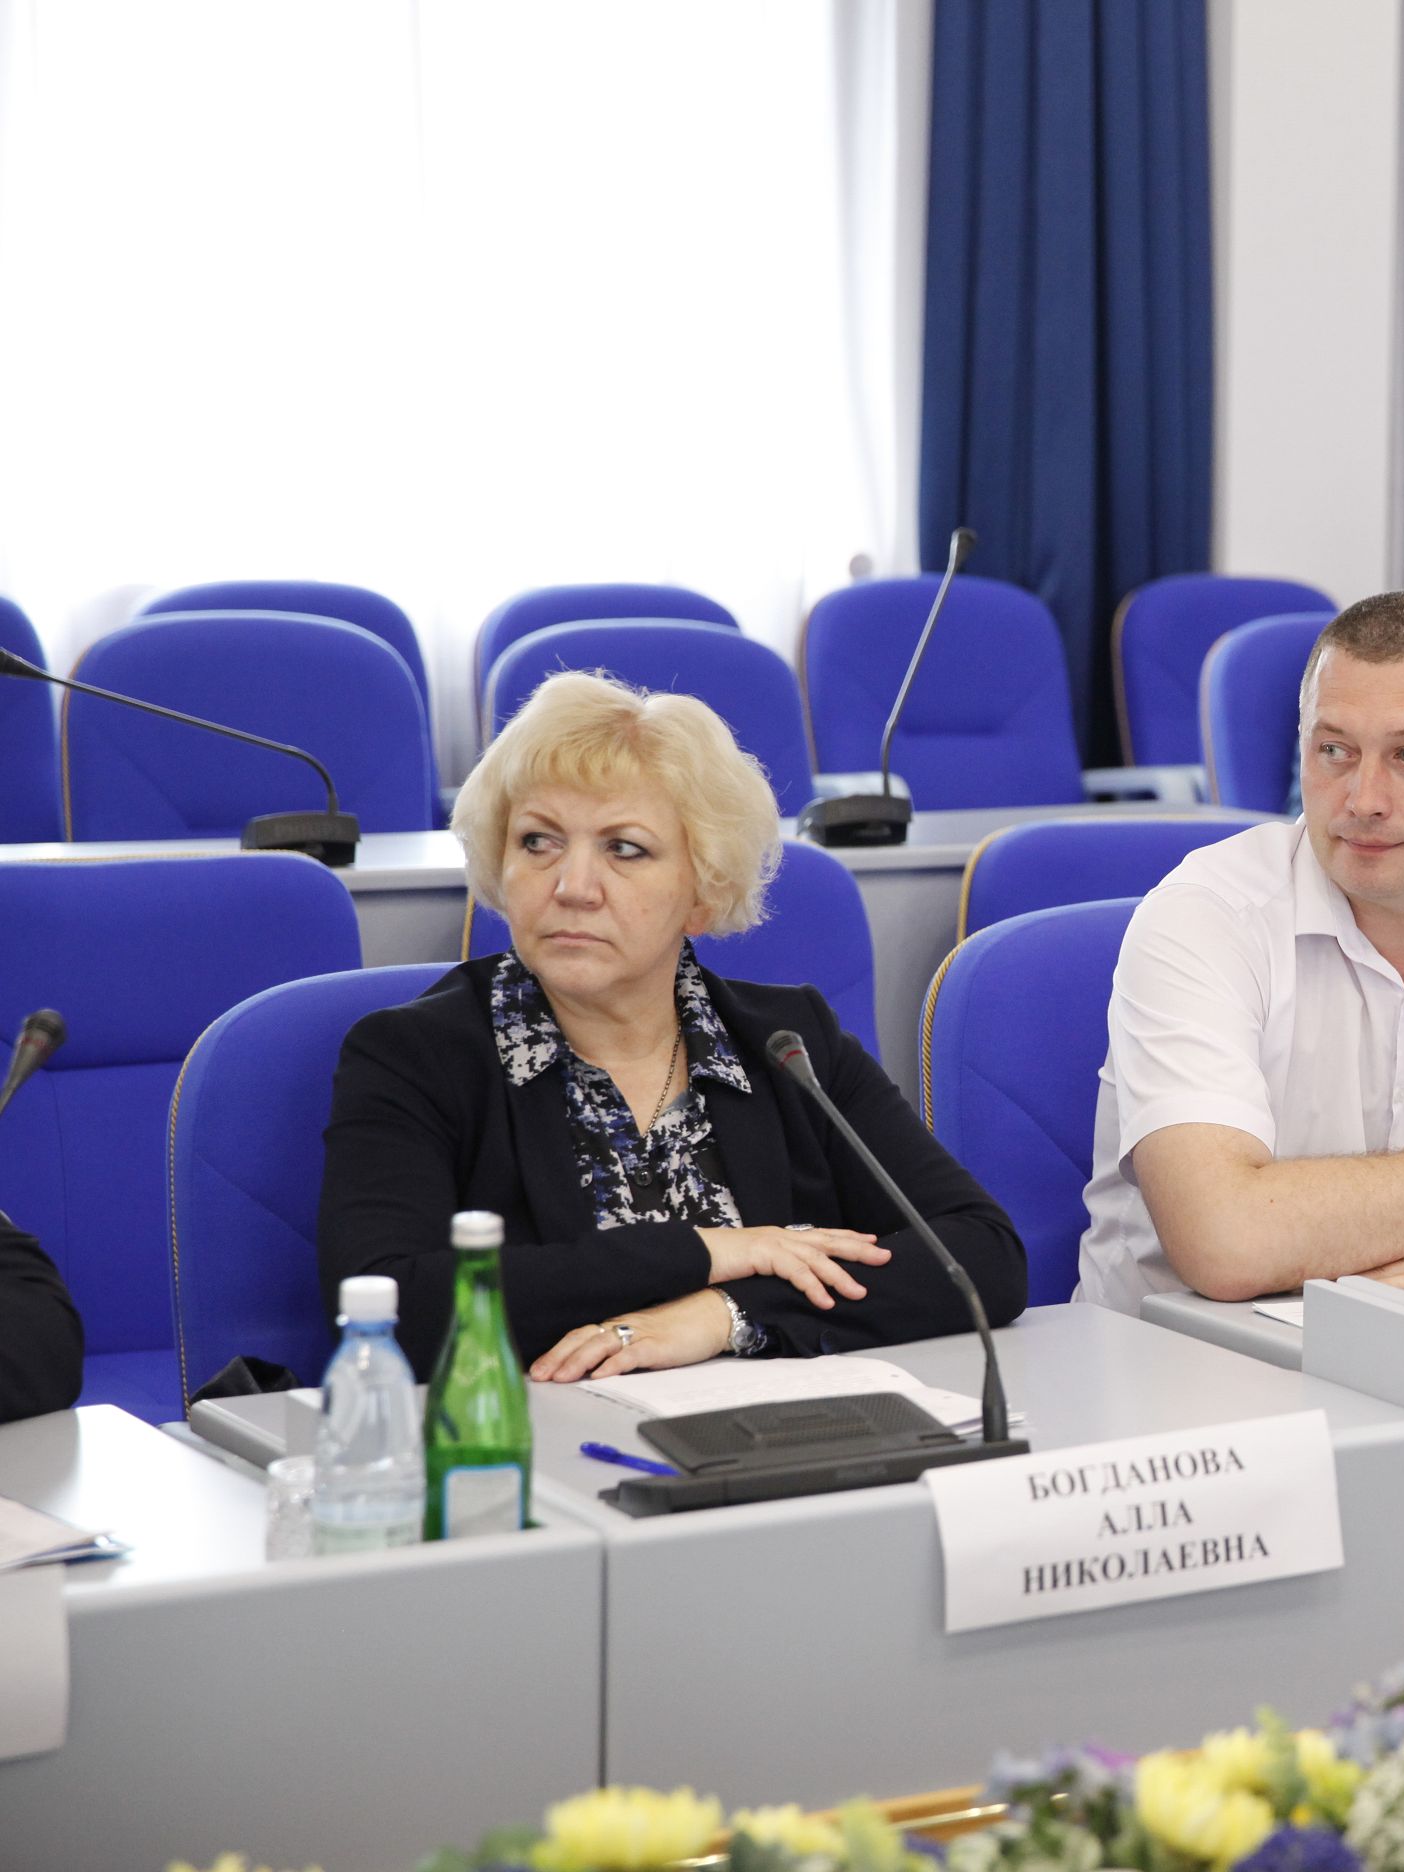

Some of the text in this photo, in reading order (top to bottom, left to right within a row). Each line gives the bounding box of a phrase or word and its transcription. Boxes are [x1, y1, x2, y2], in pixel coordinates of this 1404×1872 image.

[1027, 1447, 1244, 1501] БОГДАНОВА
[1098, 1498, 1193, 1538] АЛЛА
[1023, 1532, 1270, 1595] НИКОЛАЕВНА
